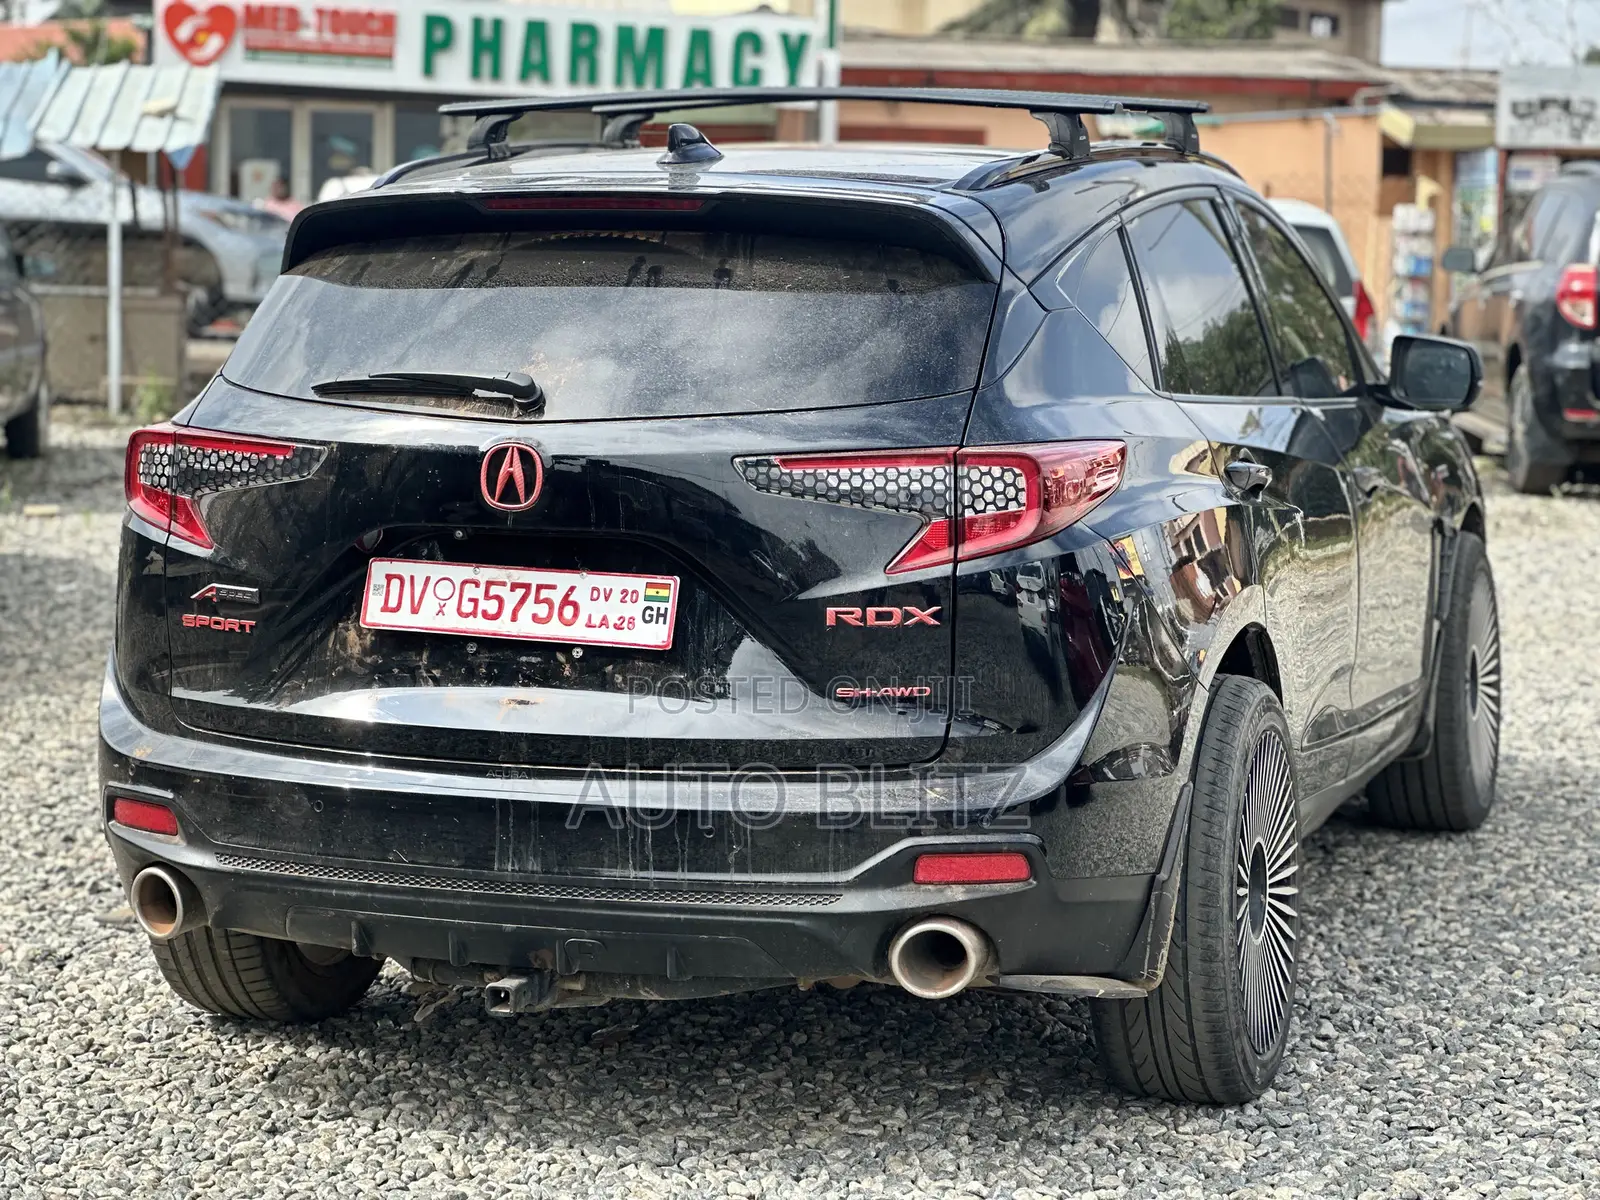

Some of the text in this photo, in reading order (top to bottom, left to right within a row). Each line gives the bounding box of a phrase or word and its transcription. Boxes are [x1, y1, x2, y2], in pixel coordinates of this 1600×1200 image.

[423, 14, 812, 89] PHARMACY
[380, 573, 431, 614] DV
[456, 578, 580, 627] G5756
[589, 586, 640, 604] DV 20
[182, 613, 257, 633] SPORT
[584, 613, 610, 629] LA
[641, 605, 669, 625] GH
[825, 606, 942, 626] RDX
[835, 686, 931, 698] SH-AWD
[486, 769, 529, 779] ACURA
